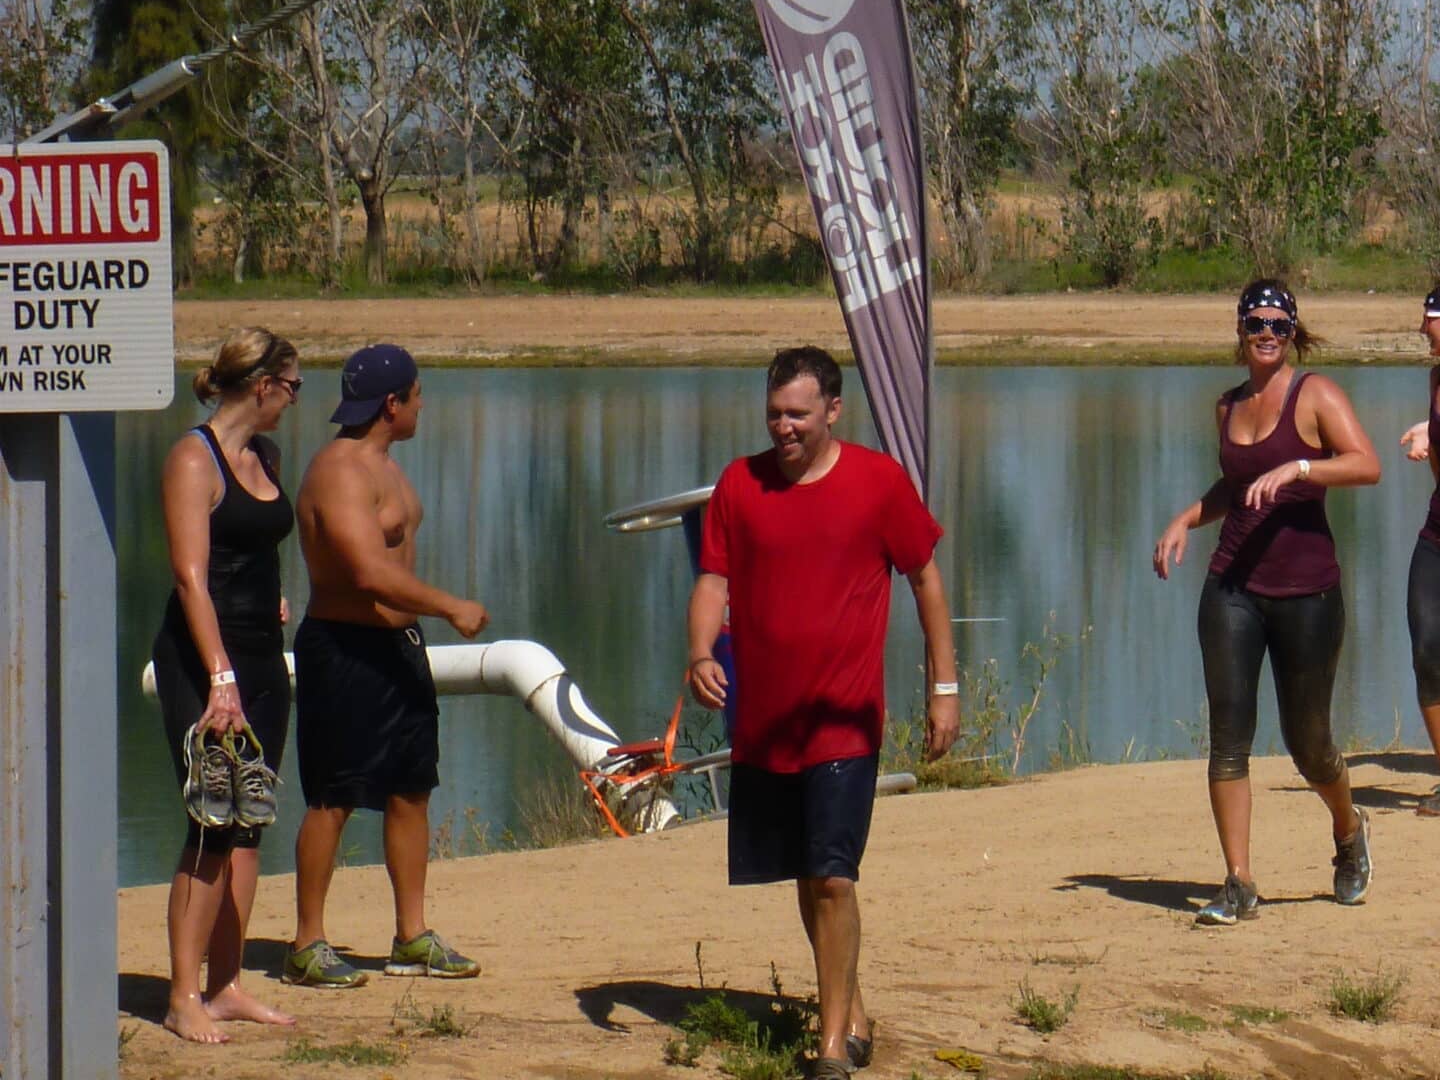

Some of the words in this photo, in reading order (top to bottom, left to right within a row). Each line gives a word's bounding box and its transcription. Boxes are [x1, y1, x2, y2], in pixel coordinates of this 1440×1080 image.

[14, 299, 100, 330] DUTY
[19, 345, 44, 366] AT
[52, 344, 112, 365] YOUR
[33, 370, 86, 391] RISK
